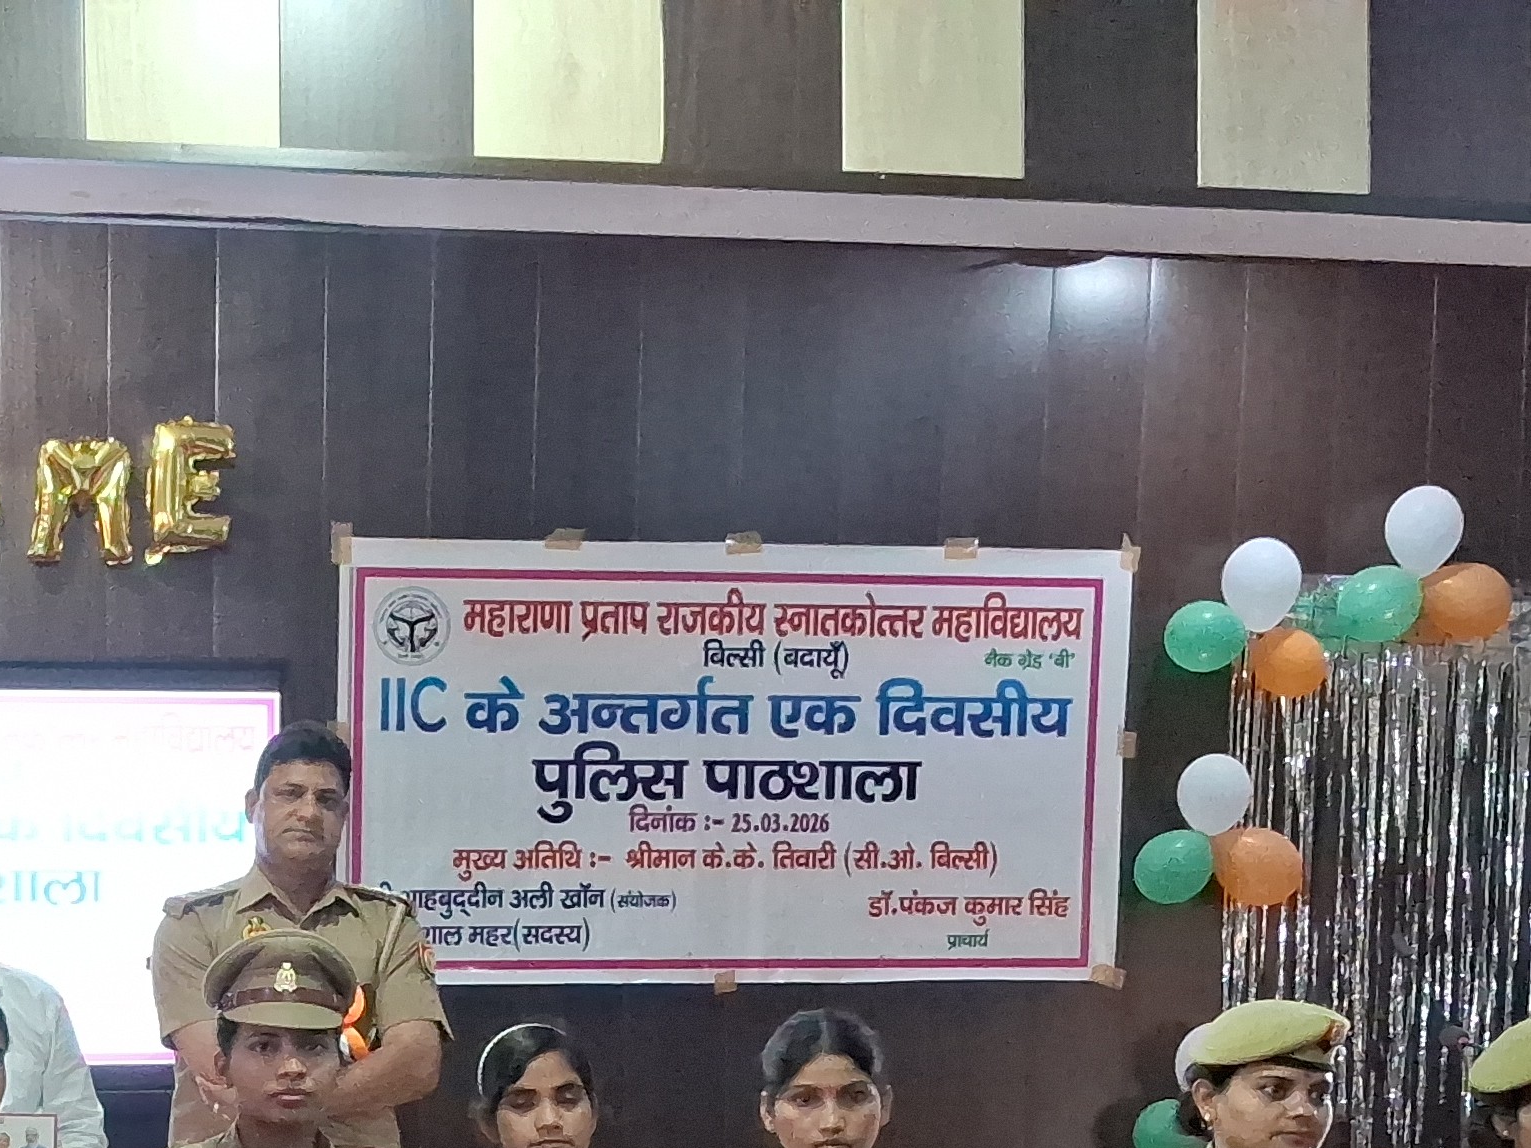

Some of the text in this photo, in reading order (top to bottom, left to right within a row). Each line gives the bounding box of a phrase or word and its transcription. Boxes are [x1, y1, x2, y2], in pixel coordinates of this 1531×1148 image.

[463, 599, 572, 637] महाराणा
[579, 600, 649, 642] प्रताप
[657, 588, 766, 635] राजकीय
[773, 591, 927, 639] स्नातकोत्तर
[931, 592, 1085, 642] महाविद्यालय
[703, 638, 766, 667] बिल्सी
[380, 675, 1074, 739] IIC के अन्तर्गत एक दिवसीय
[532, 741, 922, 823] पुलिस पाठशाला
[629, 804, 698, 833] दिनांक
[731, 812, 830, 833] 25.03.2026
[453, 848, 508, 881] मुख्य
[513, 840, 582, 870] अतिथि
[625, 840, 697, 871] श्रीमान
[772, 840, 836, 870] तिवारी
[509, 881, 554, 909] अली
[964, 895, 1025, 926] कुमार
[1028, 888, 1072, 918] सिंह
